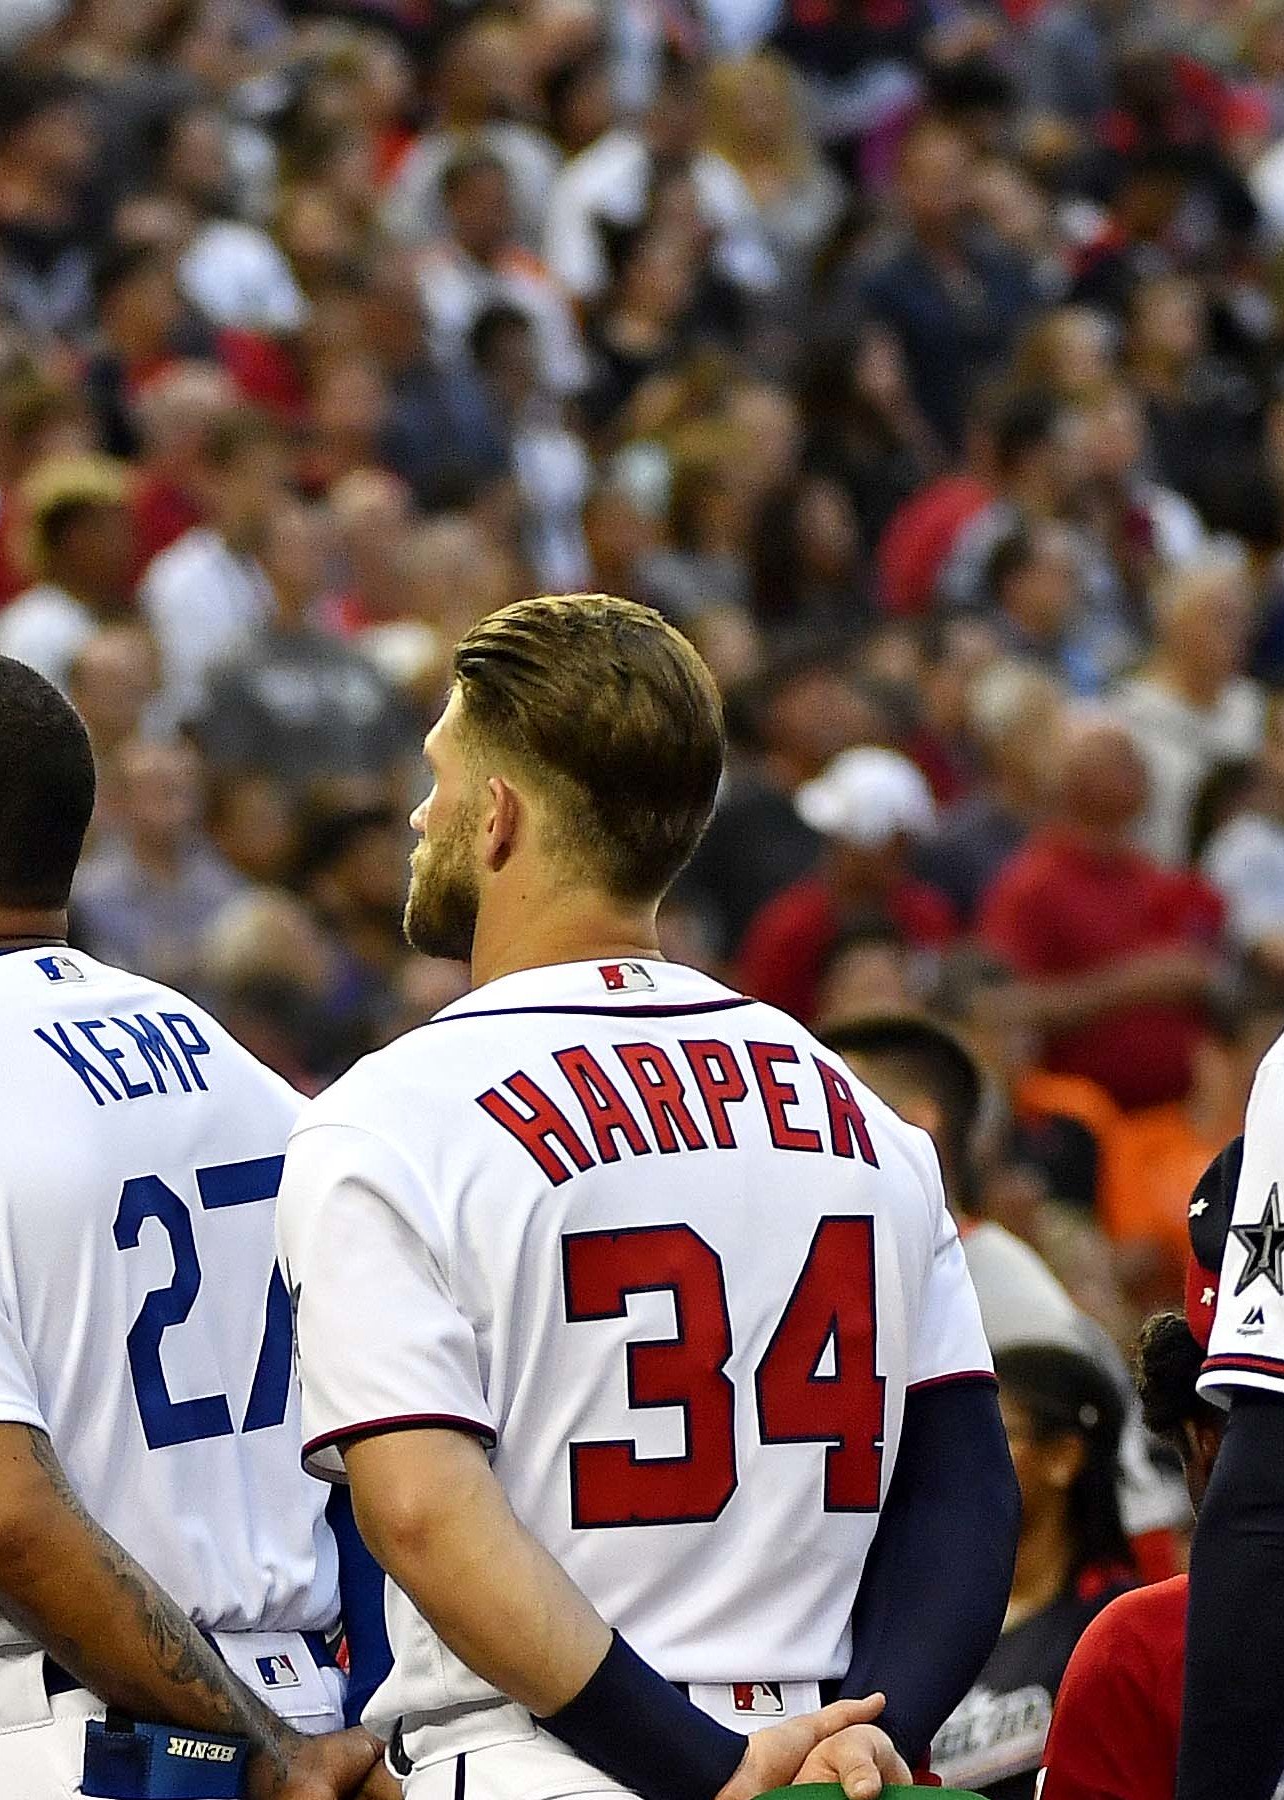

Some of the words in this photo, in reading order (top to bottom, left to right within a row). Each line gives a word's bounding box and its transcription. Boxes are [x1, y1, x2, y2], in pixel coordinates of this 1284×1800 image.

[33, 1011, 211, 1107] KEMP
[474, 1038, 881, 1188] HARPER
[112, 1153, 294, 1451] 27
[561, 1214, 888, 1530] 34
[167, 1736, 237, 1763] BENIK
